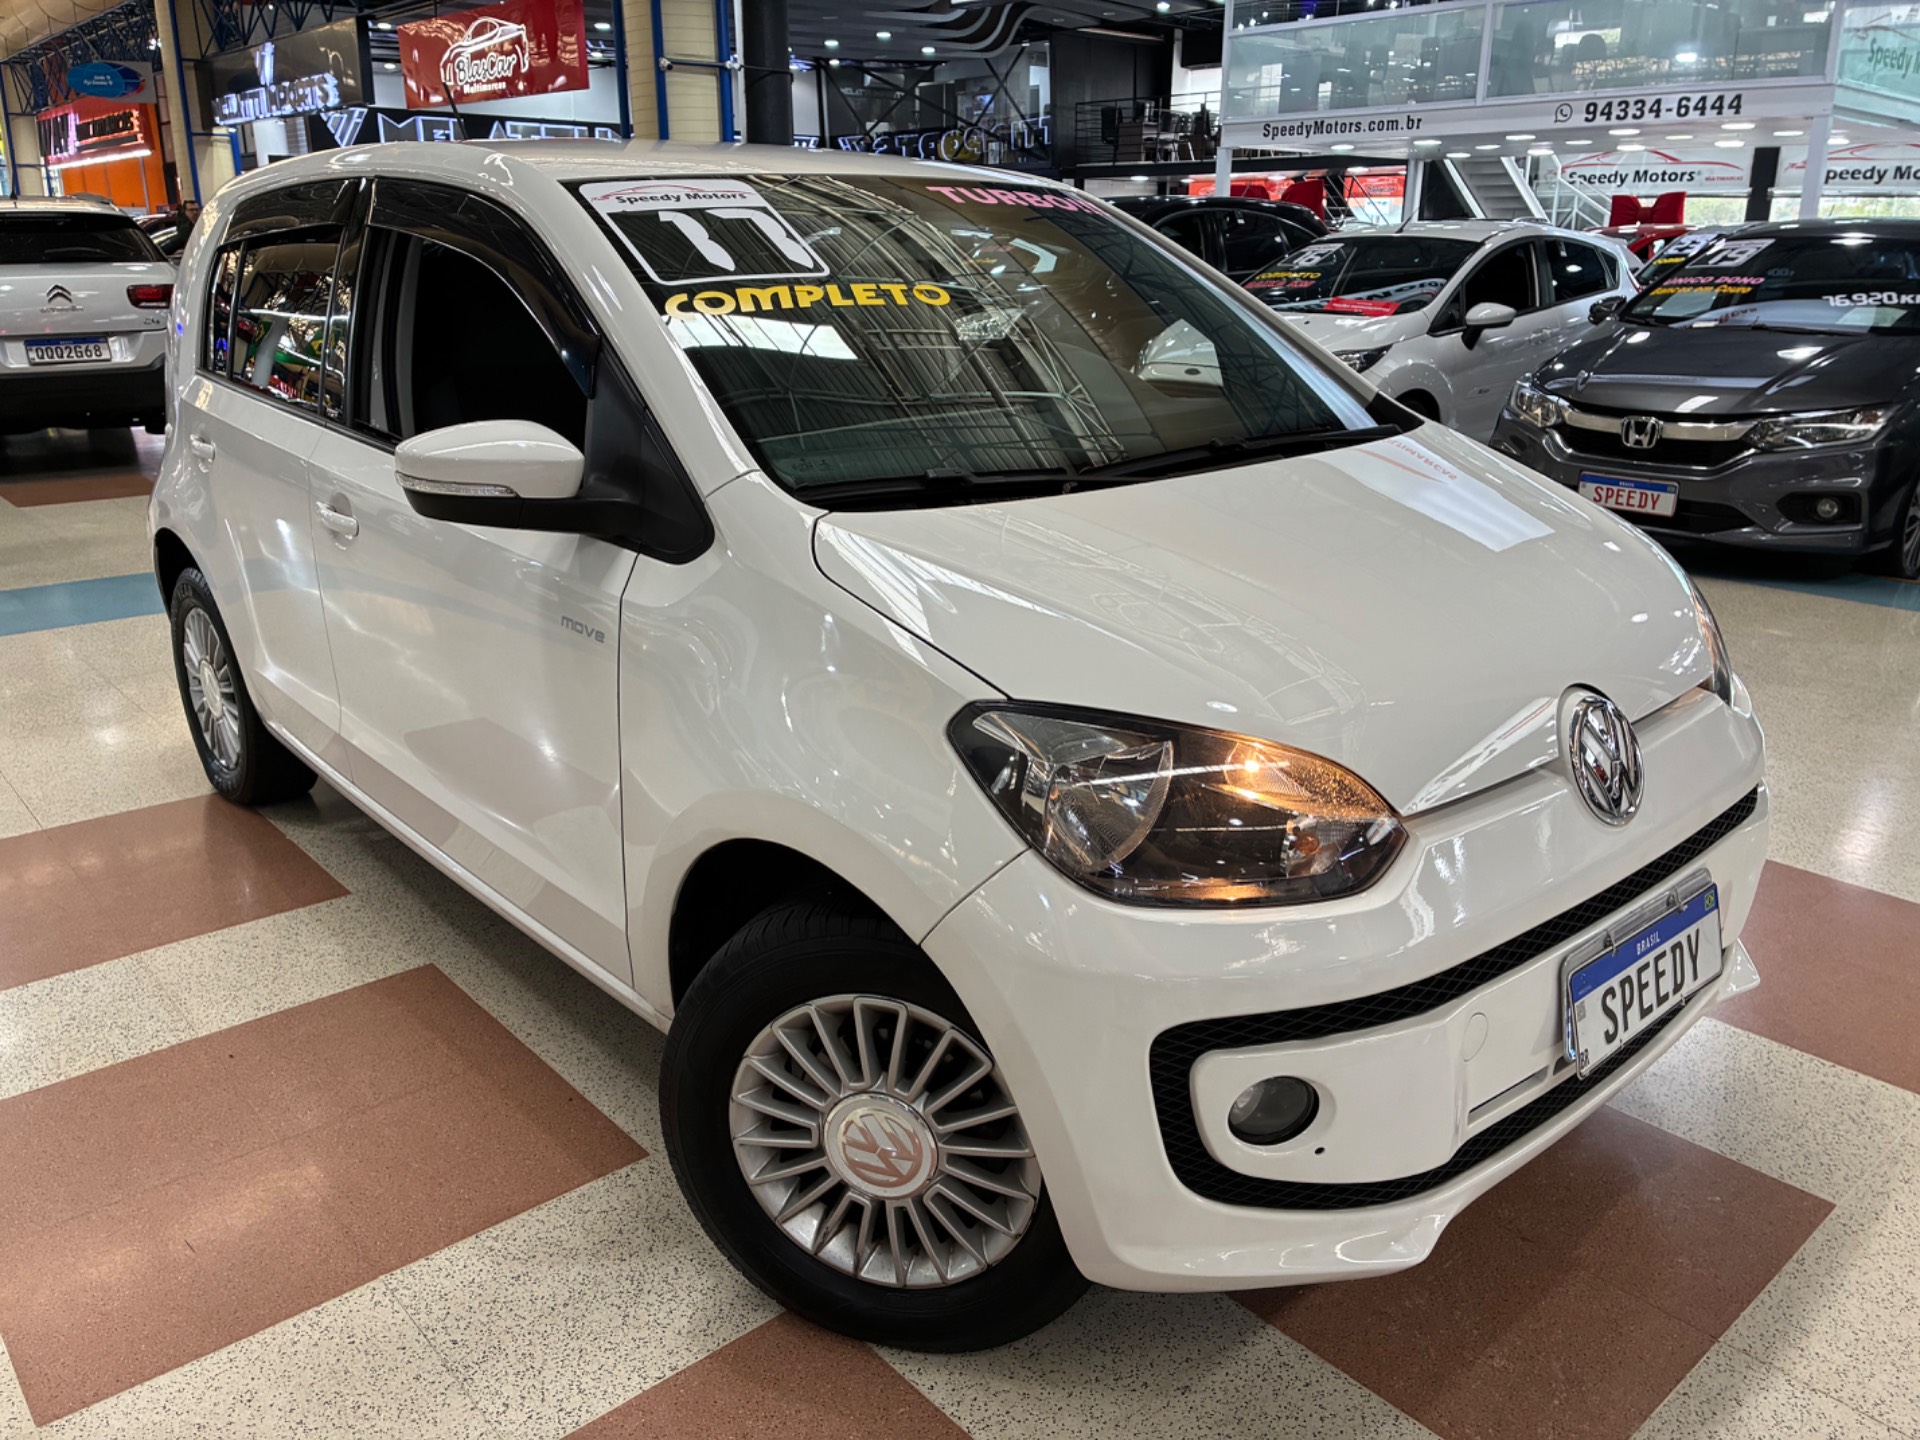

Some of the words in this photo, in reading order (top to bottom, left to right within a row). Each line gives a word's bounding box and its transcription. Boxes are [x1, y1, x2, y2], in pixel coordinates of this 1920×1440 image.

[1583, 93, 1743, 123] 94334-6444
[1262, 115, 1423, 140] SpeedyMotors.com.br
[1568, 169, 1629, 187] Speedy
[1632, 169, 1696, 183] Motors
[1825, 165, 1888, 185] peedy
[616, 192, 681, 205] Speedy
[686, 190, 748, 202] Motors
[1714, 276, 1766, 285] DONO
[664, 284, 952, 321] COMPLETO
[1593, 485, 1661, 510] SPEEDY
[561, 615, 605, 644] move
[1636, 930, 1661, 956] BRASIL
[1601, 928, 1700, 1045] SPEEDY
